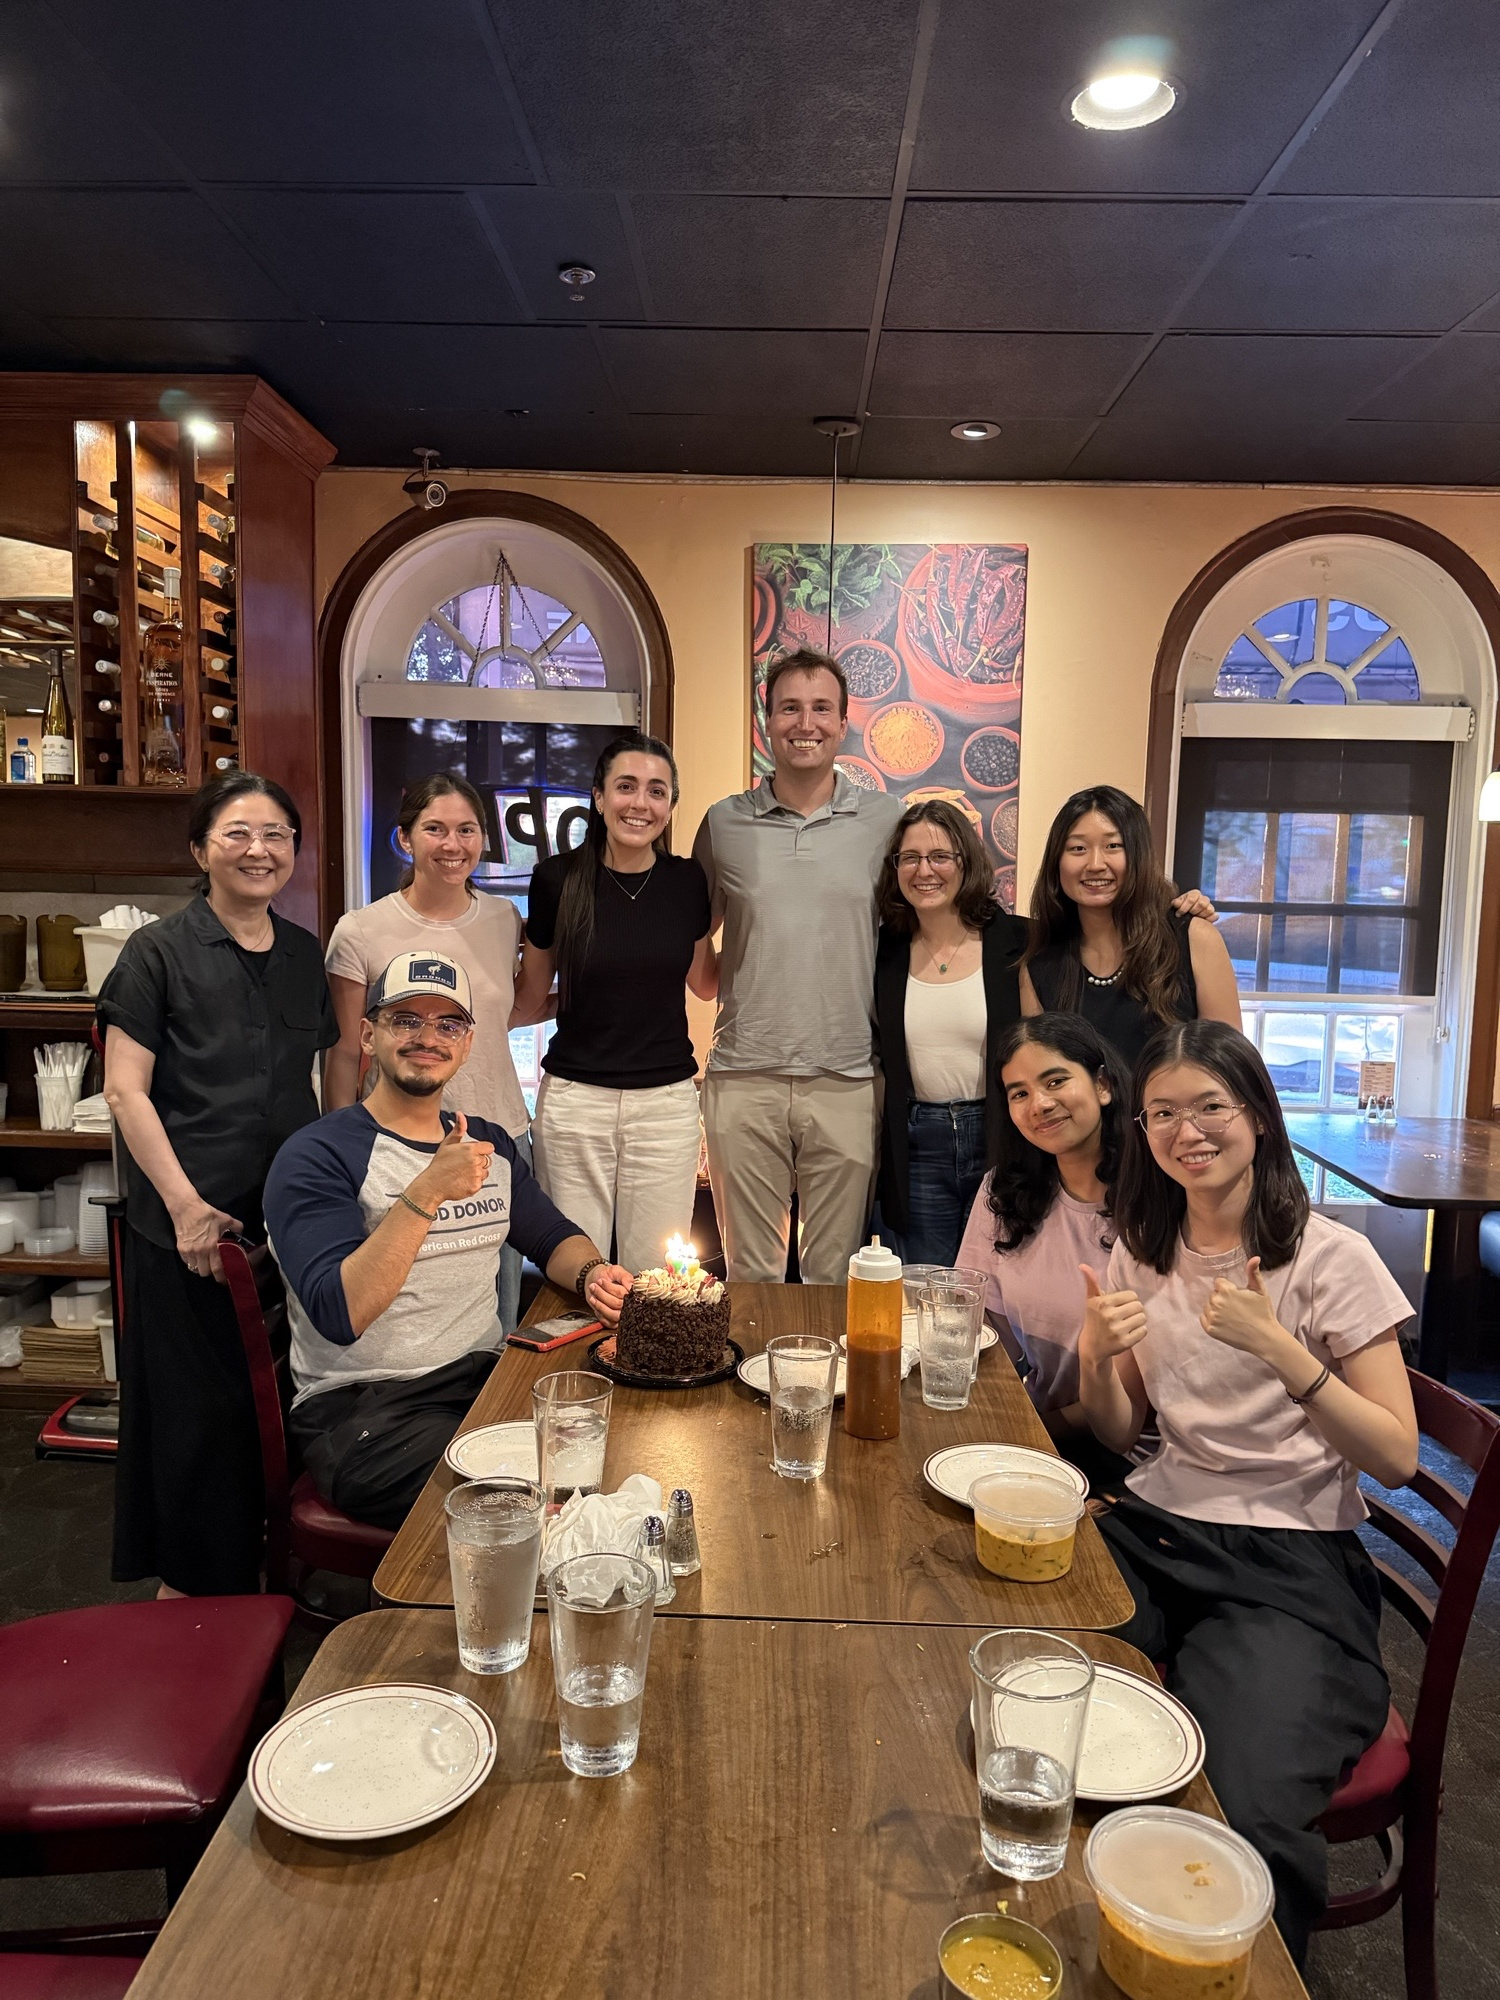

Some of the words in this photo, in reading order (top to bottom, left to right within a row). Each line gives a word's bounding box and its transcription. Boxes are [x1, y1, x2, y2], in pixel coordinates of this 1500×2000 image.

[452, 1197, 507, 1220] DONOR
[419, 1241, 457, 1252] erican
[458, 1236, 478, 1248] Red
[478, 1232, 501, 1244] Cross
